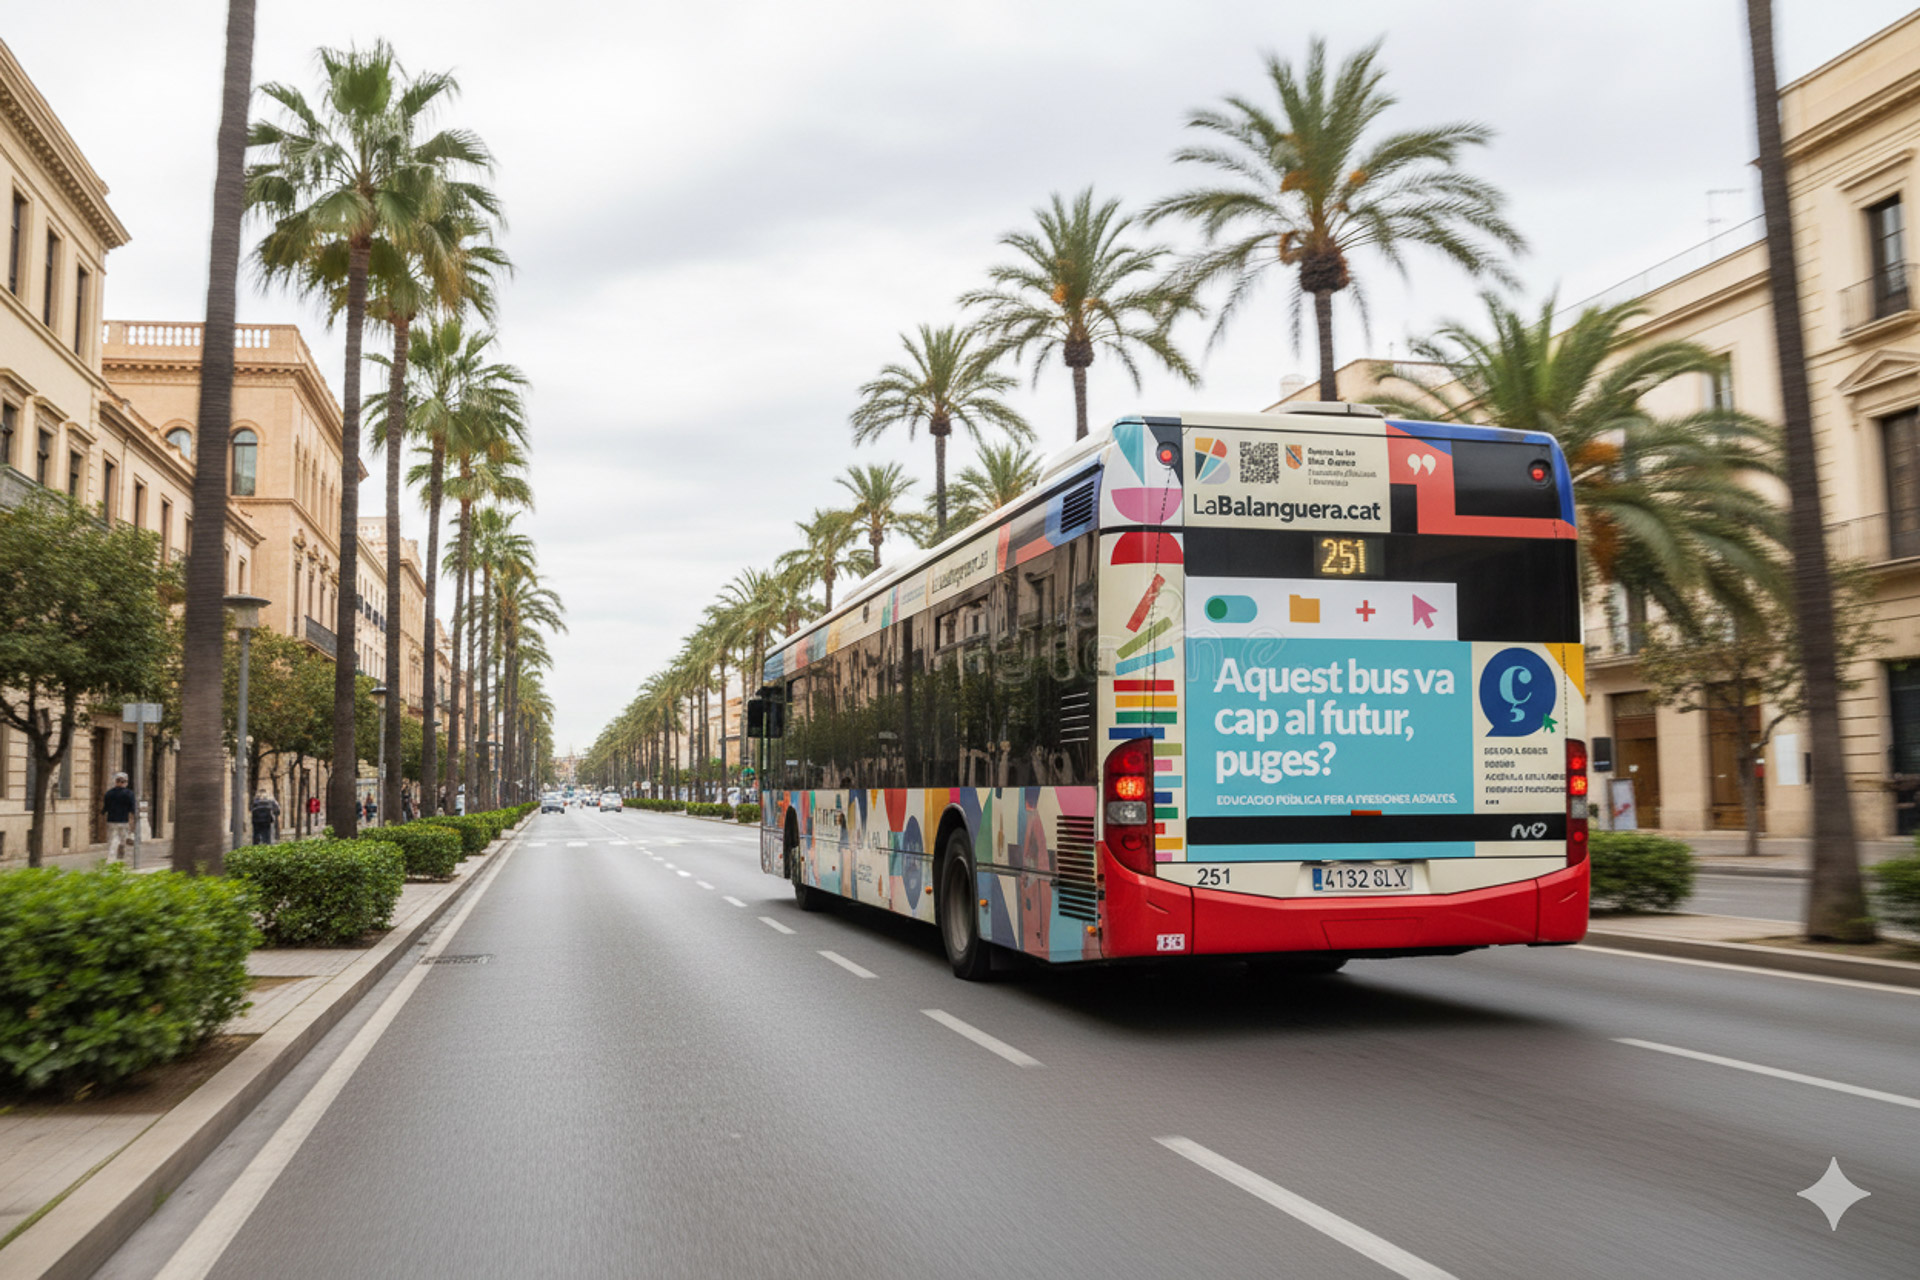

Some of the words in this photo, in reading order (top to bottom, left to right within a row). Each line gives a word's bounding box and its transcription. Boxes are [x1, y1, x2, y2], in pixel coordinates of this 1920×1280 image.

[1193, 493, 1381, 523] LaBalanguera.cat
[1320, 538, 1367, 575] 251
[1213, 658, 1343, 701] Aquest
[1348, 658, 1409, 694] bus
[1414, 668, 1455, 694] va
[1214, 708, 1279, 742] cap
[1284, 699, 1315, 735] al
[1320, 700, 1414, 741] futur,
[1216, 741, 1337, 784] puges?
[1197, 868, 1231, 886] 251
[1325, 868, 1369, 888] 4132
